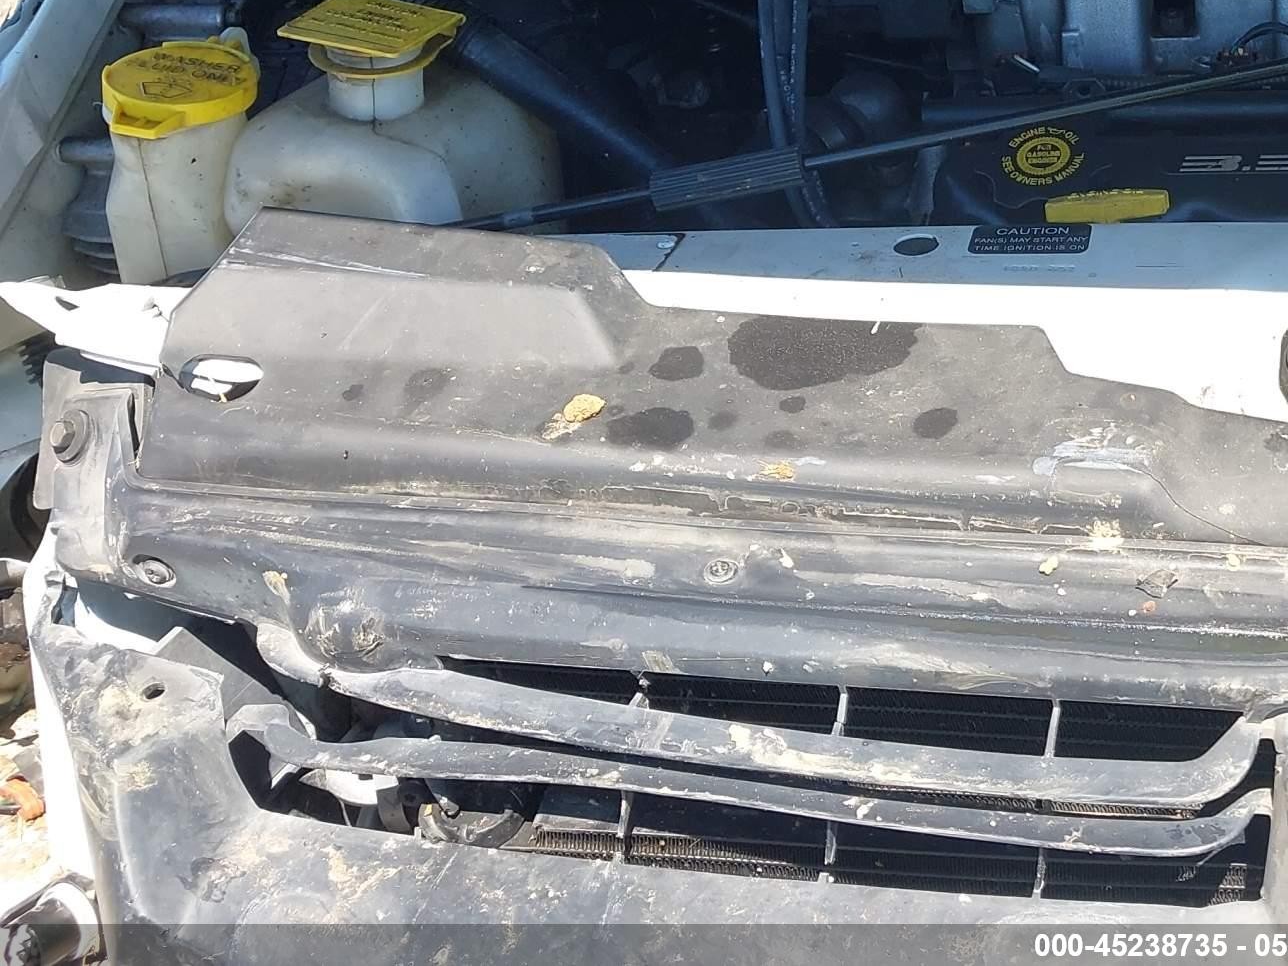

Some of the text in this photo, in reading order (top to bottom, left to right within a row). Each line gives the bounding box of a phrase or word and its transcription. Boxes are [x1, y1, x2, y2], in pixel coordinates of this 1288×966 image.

[124, 58, 248, 86] FLUID ONLY
[153, 52, 241, 74] WASHER
[1008, 127, 1080, 148] ENGINE OIL
[1001, 152, 1085, 186] SEE OWNERS MANUAL
[996, 226, 1070, 235] CAUTION
